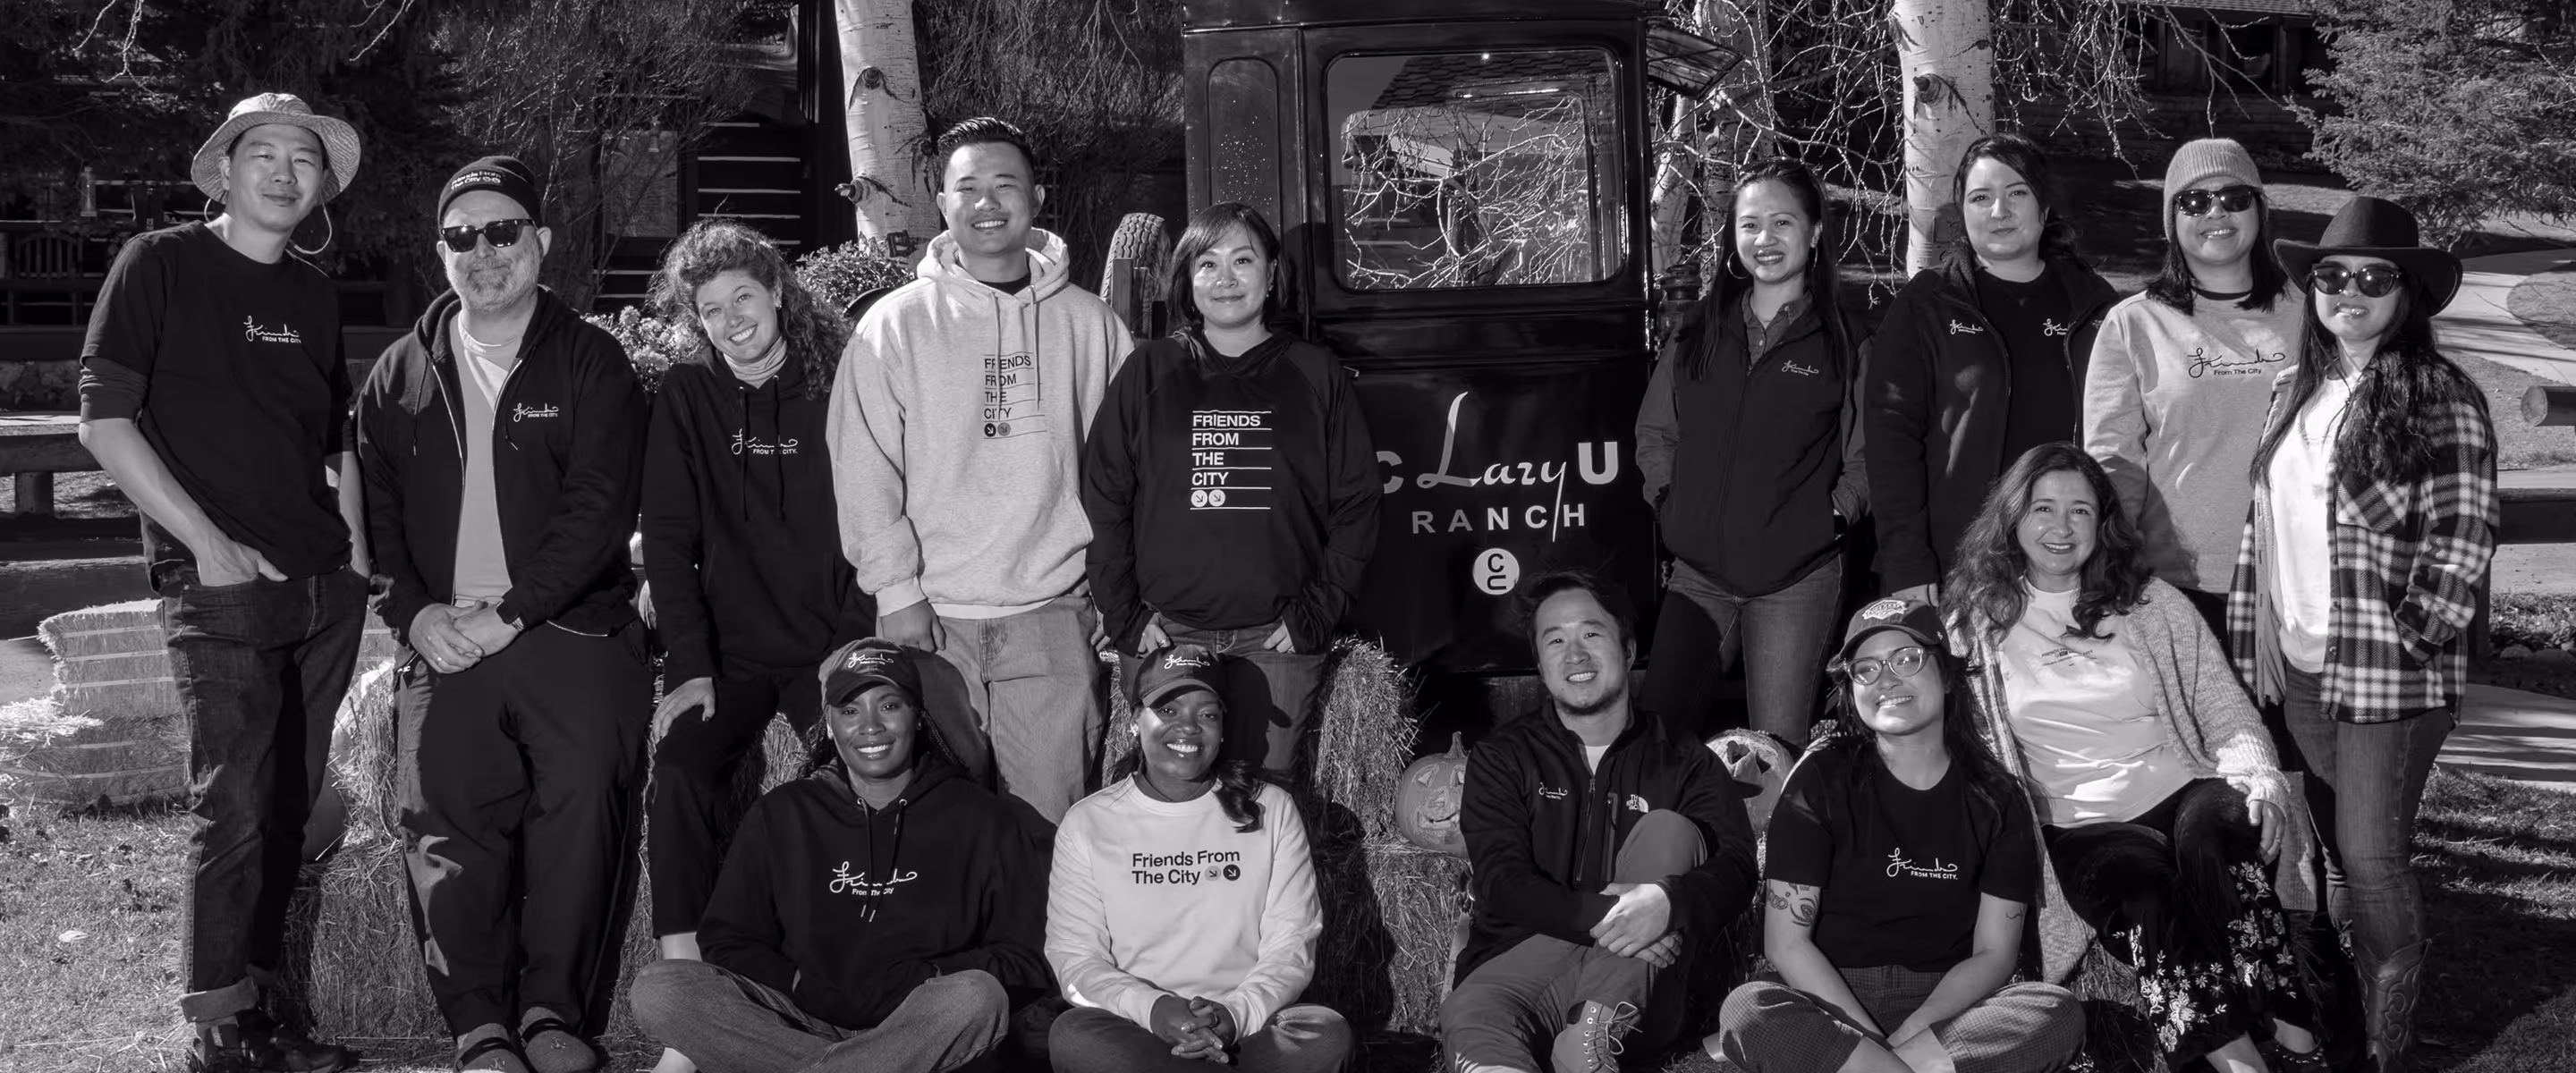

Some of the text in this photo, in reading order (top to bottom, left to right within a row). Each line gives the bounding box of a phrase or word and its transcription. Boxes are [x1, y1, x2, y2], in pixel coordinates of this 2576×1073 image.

[985, 355, 1032, 370] FRENDS
[2248, 368, 2262, 376] City
[985, 374, 1017, 387] FROM
[985, 391, 1008, 403] THE
[1192, 414, 1261, 427] FRIENDS
[1192, 432, 1239, 446] FROM
[1191, 452, 1224, 467] THE
[1416, 391, 1567, 543] Lazy
[1578, 441, 1619, 485] U
[1191, 471, 1229, 486] CITY
[1411, 503, 1586, 535] RANCH
[1131, 849, 1241, 868] Friends From
[1131, 868, 1201, 885] The City
[1911, 870, 1928, 878] FROM
